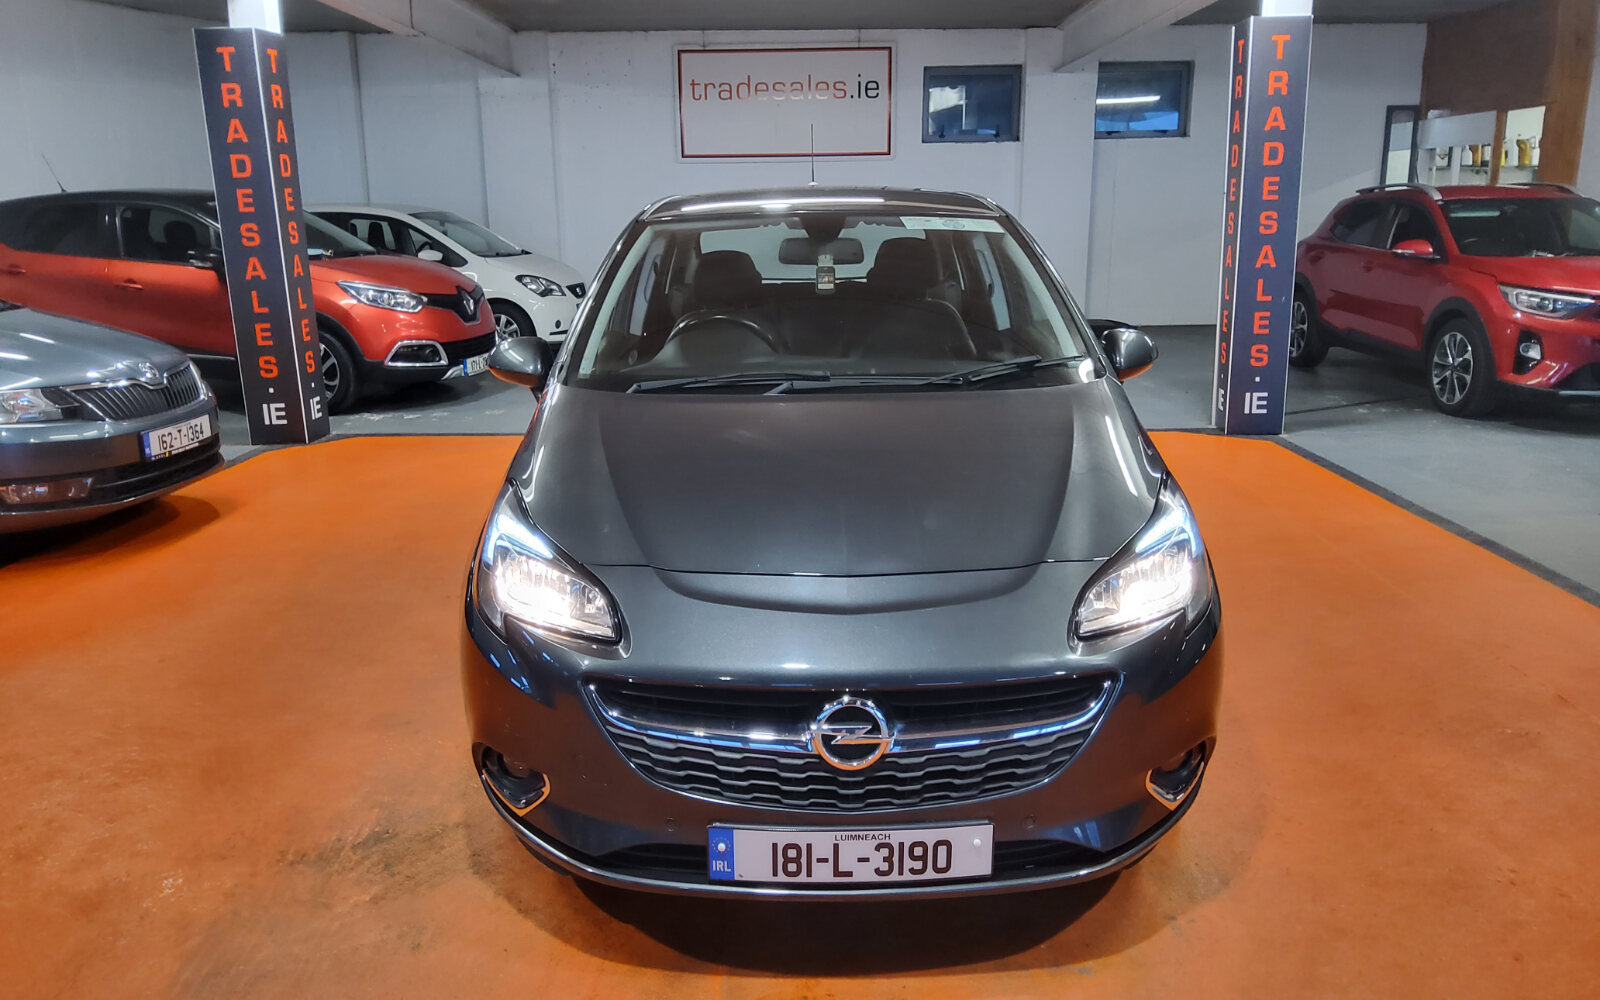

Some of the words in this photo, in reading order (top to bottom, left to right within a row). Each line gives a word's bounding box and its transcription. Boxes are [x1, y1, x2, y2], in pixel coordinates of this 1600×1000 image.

[690, 73, 880, 101] tradesales.ie
[157, 422, 204, 451] 162-T-1364
[834, 833, 892, 842] LUIMNEACH
[712, 859, 732, 873] IRL
[771, 839, 953, 878] 181-L-3190
